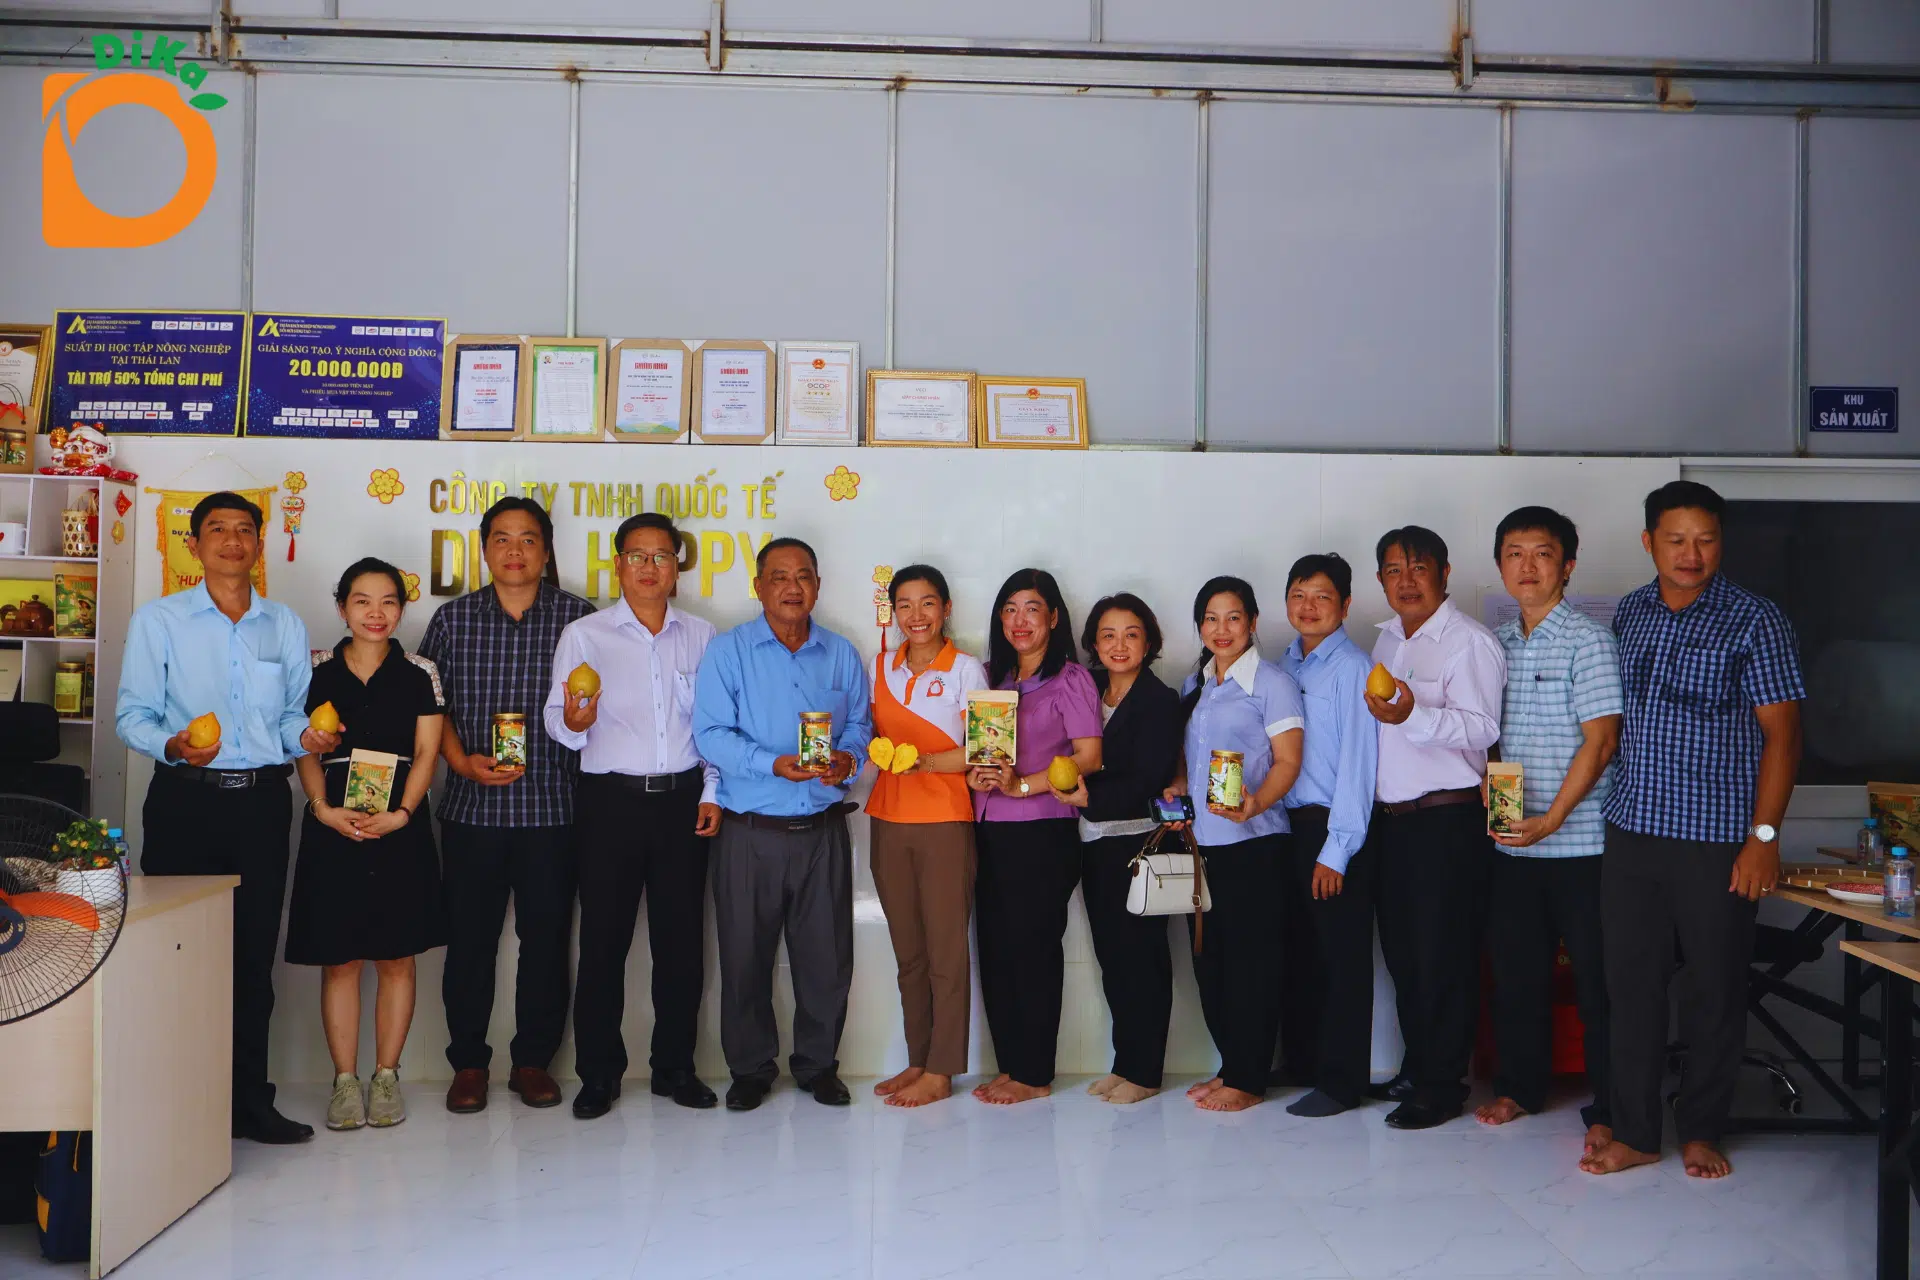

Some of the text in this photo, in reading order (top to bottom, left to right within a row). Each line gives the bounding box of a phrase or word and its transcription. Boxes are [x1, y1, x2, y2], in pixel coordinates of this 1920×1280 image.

[64, 341, 231, 355] SUẤT ĐI HỌC TẬP NÔNG NGHIỆP
[257, 343, 437, 357] GIẢI SÁNG TẠO, Ý NGHĨA CỘNG ĐỒNG
[111, 354, 181, 366] TẠI THÁI LAN
[289, 359, 403, 379] 20.000.000Đ
[67, 368, 224, 387] TÀI TRỢ 50% TỔNG CHI PHÍ
[1843, 394, 1864, 405] KHU
[1820, 408, 1888, 427] SẢN XUẤT
[430, 468, 785, 520] CÔNG TY TNHH QUỐC TẾ
[586, 530, 774, 599] HPPY
